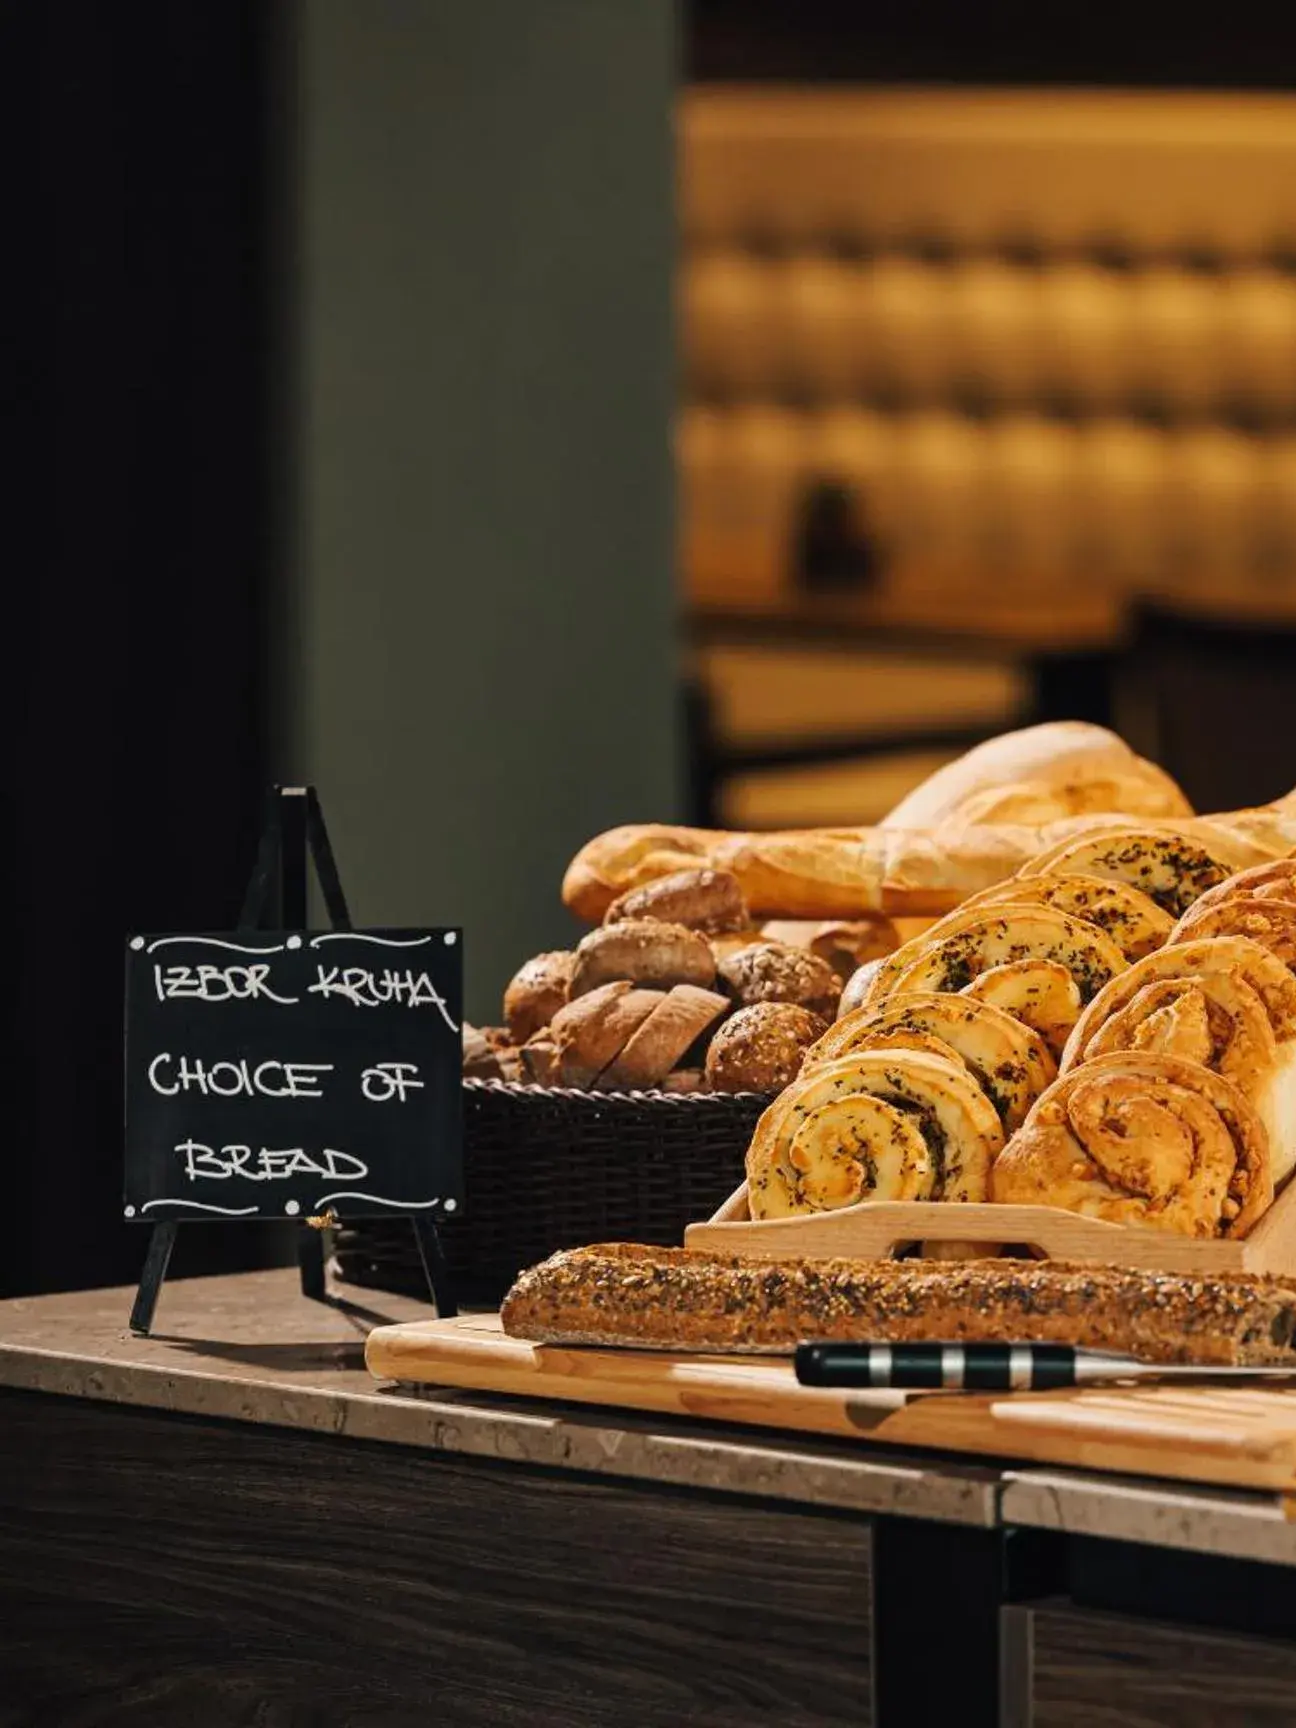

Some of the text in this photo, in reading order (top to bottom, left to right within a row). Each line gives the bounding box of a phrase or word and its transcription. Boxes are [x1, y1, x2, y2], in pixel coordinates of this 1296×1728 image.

[154, 963, 460, 1033] IZBOR KRUHA
[148, 1052, 425, 1103] CHOICE OF
[174, 1138, 369, 1182] BREAD
